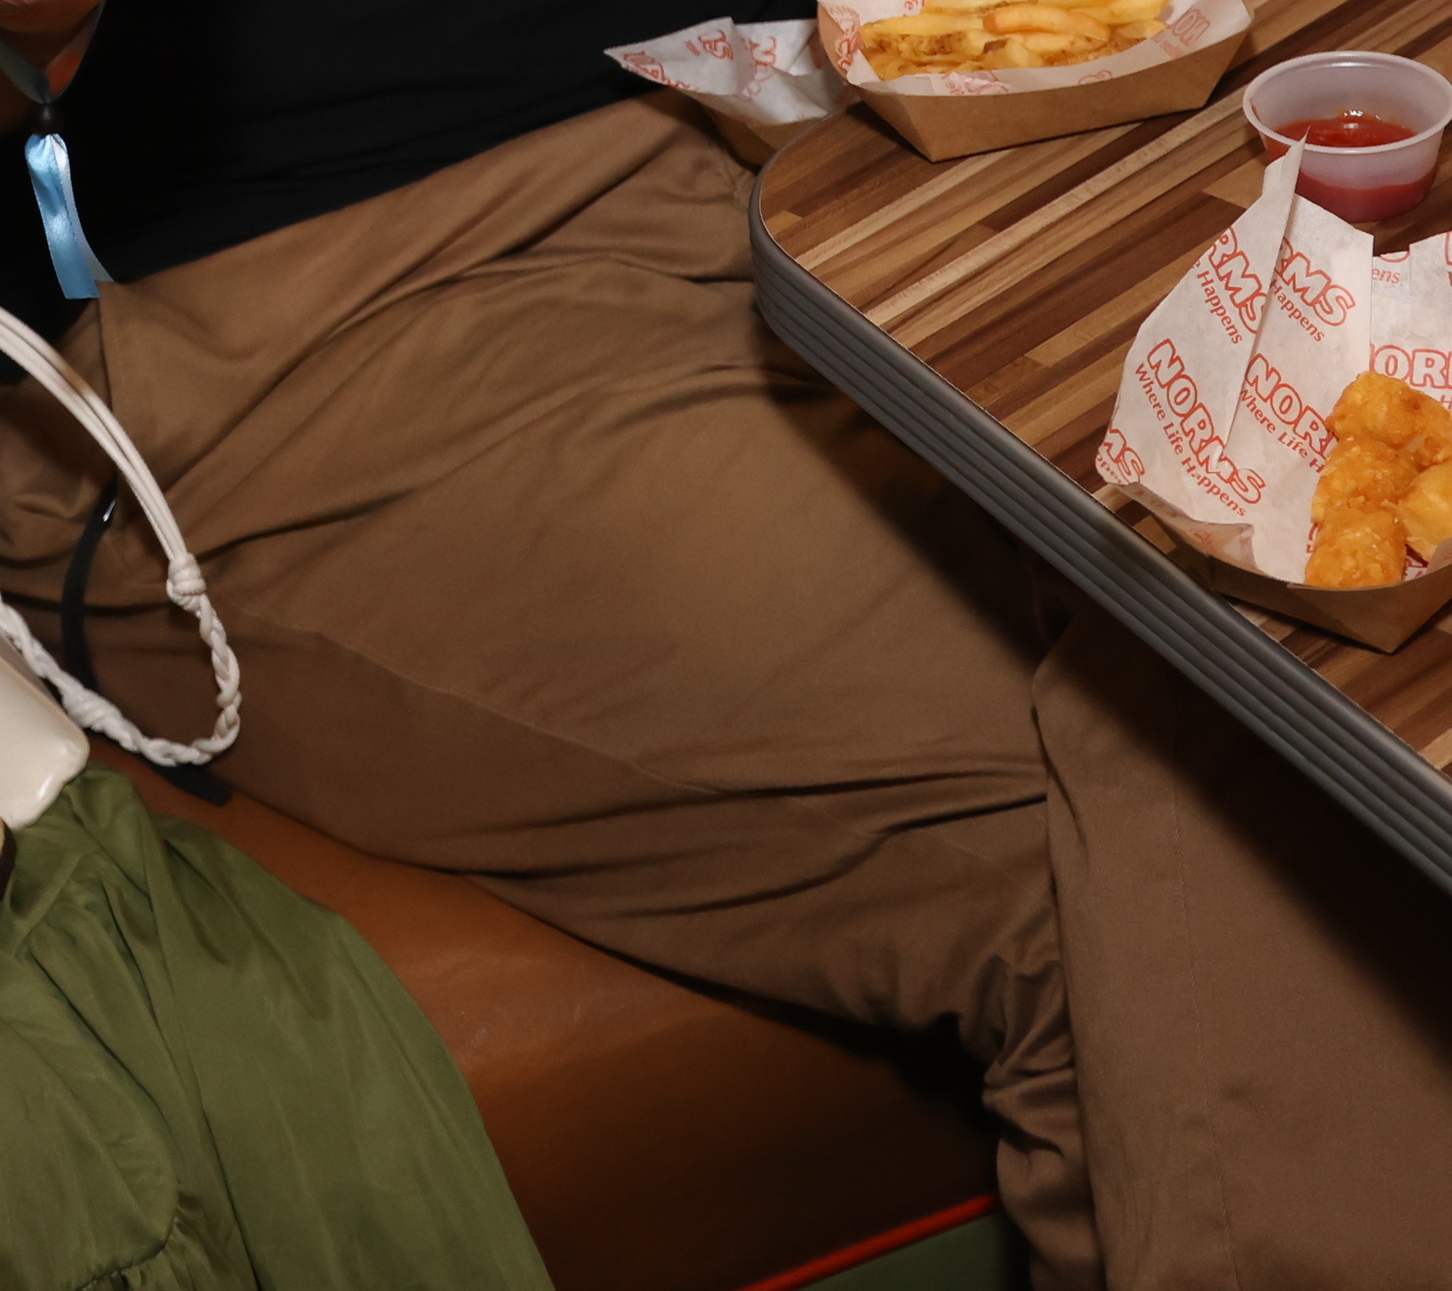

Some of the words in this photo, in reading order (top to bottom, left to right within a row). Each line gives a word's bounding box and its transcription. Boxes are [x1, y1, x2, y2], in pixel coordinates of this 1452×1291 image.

[1197, 271, 1243, 344] Happens
[1209, 226, 1268, 334] RMS
[1270, 279, 1325, 343] Happens
[1135, 362, 1166, 421] Where
[1163, 422, 1184, 455] Life
[1181, 456, 1247, 517] Happens
[1147, 338, 1267, 504] NORMS
[1245, 353, 1340, 460] NOR
[1278, 431, 1309, 459] Life
